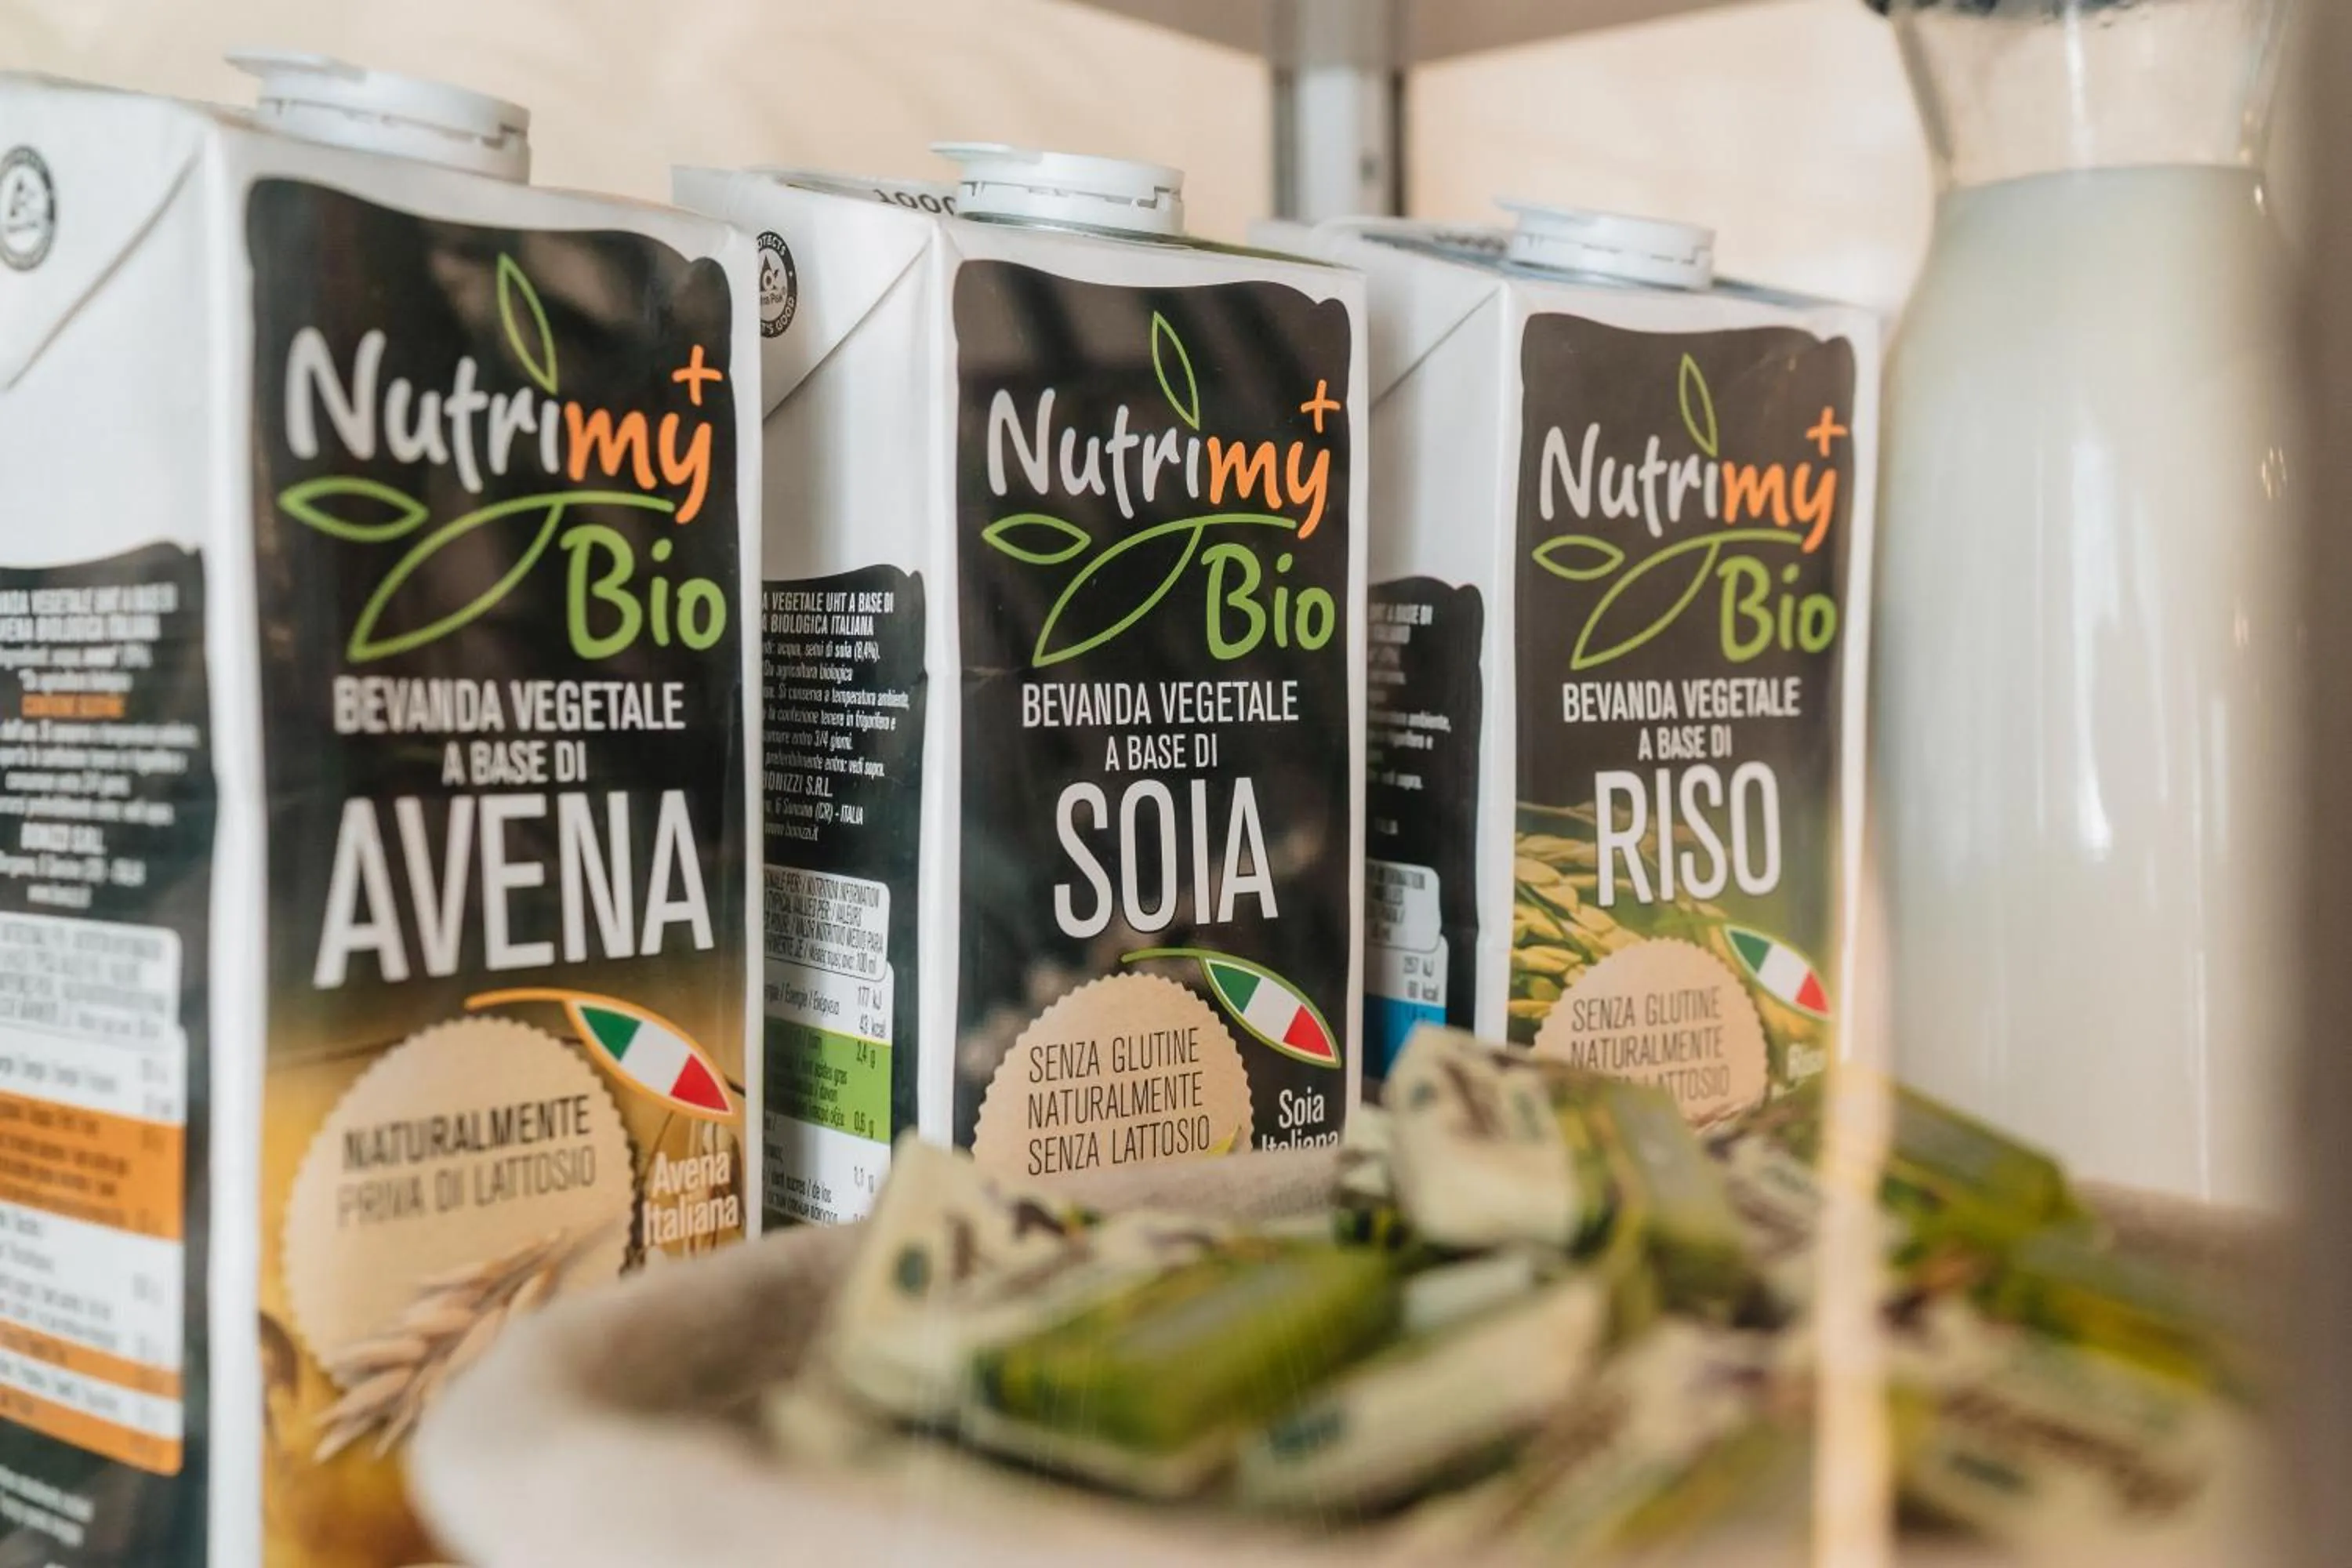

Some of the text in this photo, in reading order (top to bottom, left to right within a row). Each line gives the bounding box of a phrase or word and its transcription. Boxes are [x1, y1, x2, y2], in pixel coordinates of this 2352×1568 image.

[559, 524, 727, 660] Bio
[772, 592, 823, 612] VEGETALE
[826, 592, 847, 612] UHT
[848, 592, 855, 612] A
[858, 592, 882, 613] BASE
[884, 592, 895, 613] DI
[1201, 542, 1335, 660] Bio
[1715, 555, 1838, 663] Bio
[771, 614, 828, 634] BIOLOGICA
[830, 615, 874, 637] ITALIANA
[332, 675, 685, 734] BEVANDA VEGETALE
[1022, 680, 1299, 728] BEVANDA VEGETALE
[1562, 676, 1802, 723] BEVANDA VEGETALE
[441, 740, 586, 786] A BASE DI
[1105, 732, 1218, 771] A BASE DI
[1637, 724, 1733, 761] A BASE DI
[840, 804, 863, 826] ITALIA
[1594, 760, 1782, 908] RISO
[1054, 776, 1279, 938] SOIA
[313, 789, 715, 990] AVENA
[1571, 985, 1724, 1033] SENZA GLUTINE
[1029, 1026, 1200, 1083] SENZA GLUTINE
[1571, 1025, 1725, 1071] NATURALMENTE
[1027, 1070, 1203, 1130] NATURALMENTE
[1278, 1085, 1325, 1130] Soia
[341, 1094, 592, 1171] NATURALMENTE
[1027, 1114, 1211, 1176] SENZA LATTOSIO
[336, 1145, 597, 1229] PRIVA DI LATTOSIO
[652, 1149, 731, 1197] Avena
[642, 1193, 739, 1248] Italiana
